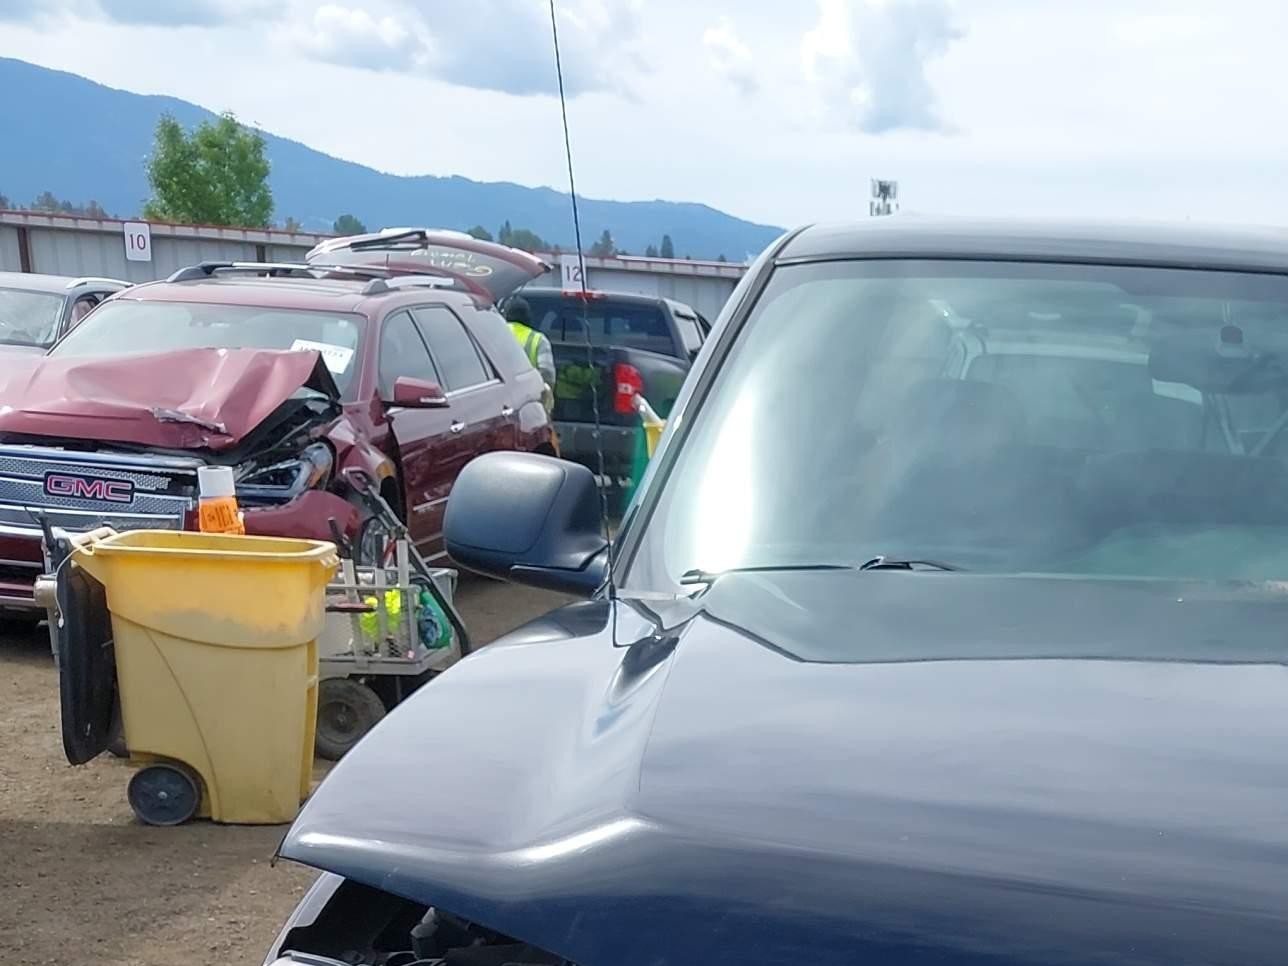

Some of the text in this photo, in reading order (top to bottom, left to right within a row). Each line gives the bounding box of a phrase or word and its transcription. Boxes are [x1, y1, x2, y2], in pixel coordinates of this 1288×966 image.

[130, 234, 146, 250] 10
[566, 265, 583, 282] 12
[47, 475, 132, 502] GMC
